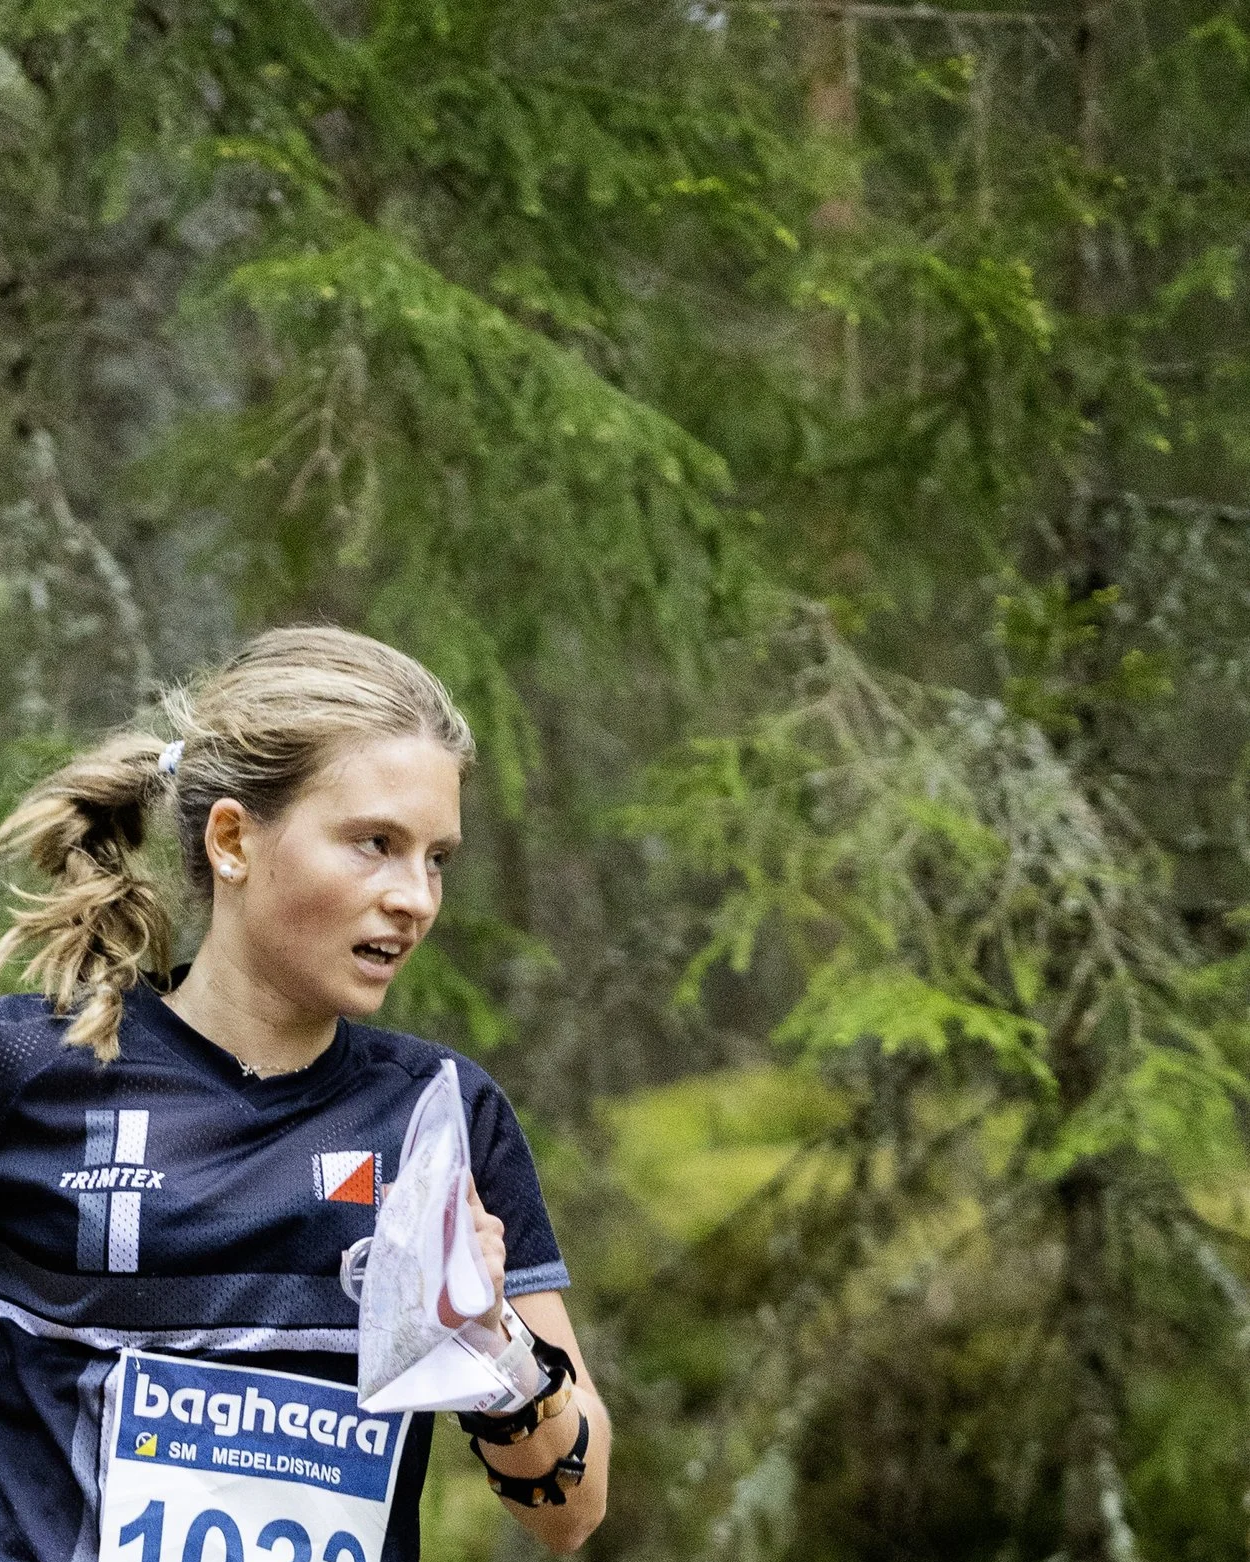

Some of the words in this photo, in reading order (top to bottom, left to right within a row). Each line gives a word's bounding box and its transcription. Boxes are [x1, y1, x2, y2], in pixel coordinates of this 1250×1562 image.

[59, 1167, 166, 1190] TRIMTEX
[133, 1373, 390, 1456] bagheera
[168, 1440, 197, 1462] SM
[212, 1446, 342, 1485] MEDELDISTANS
